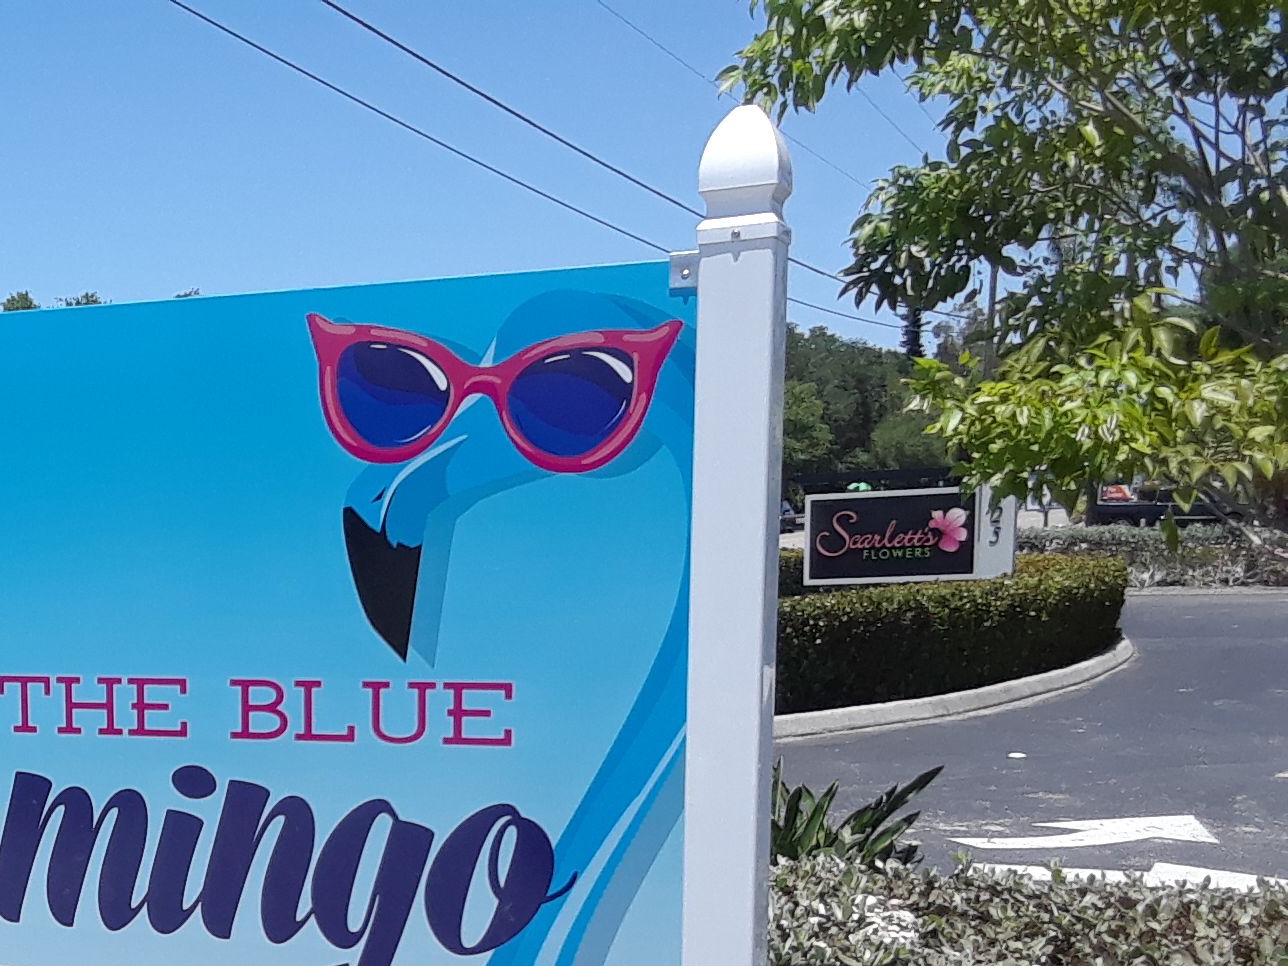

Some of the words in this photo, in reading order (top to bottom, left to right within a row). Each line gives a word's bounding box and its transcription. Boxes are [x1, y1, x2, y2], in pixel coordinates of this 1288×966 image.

[816, 510, 939, 557] Scarlett's
[863, 549, 931, 560] FLOWERS
[229, 679, 514, 747] BLUE
